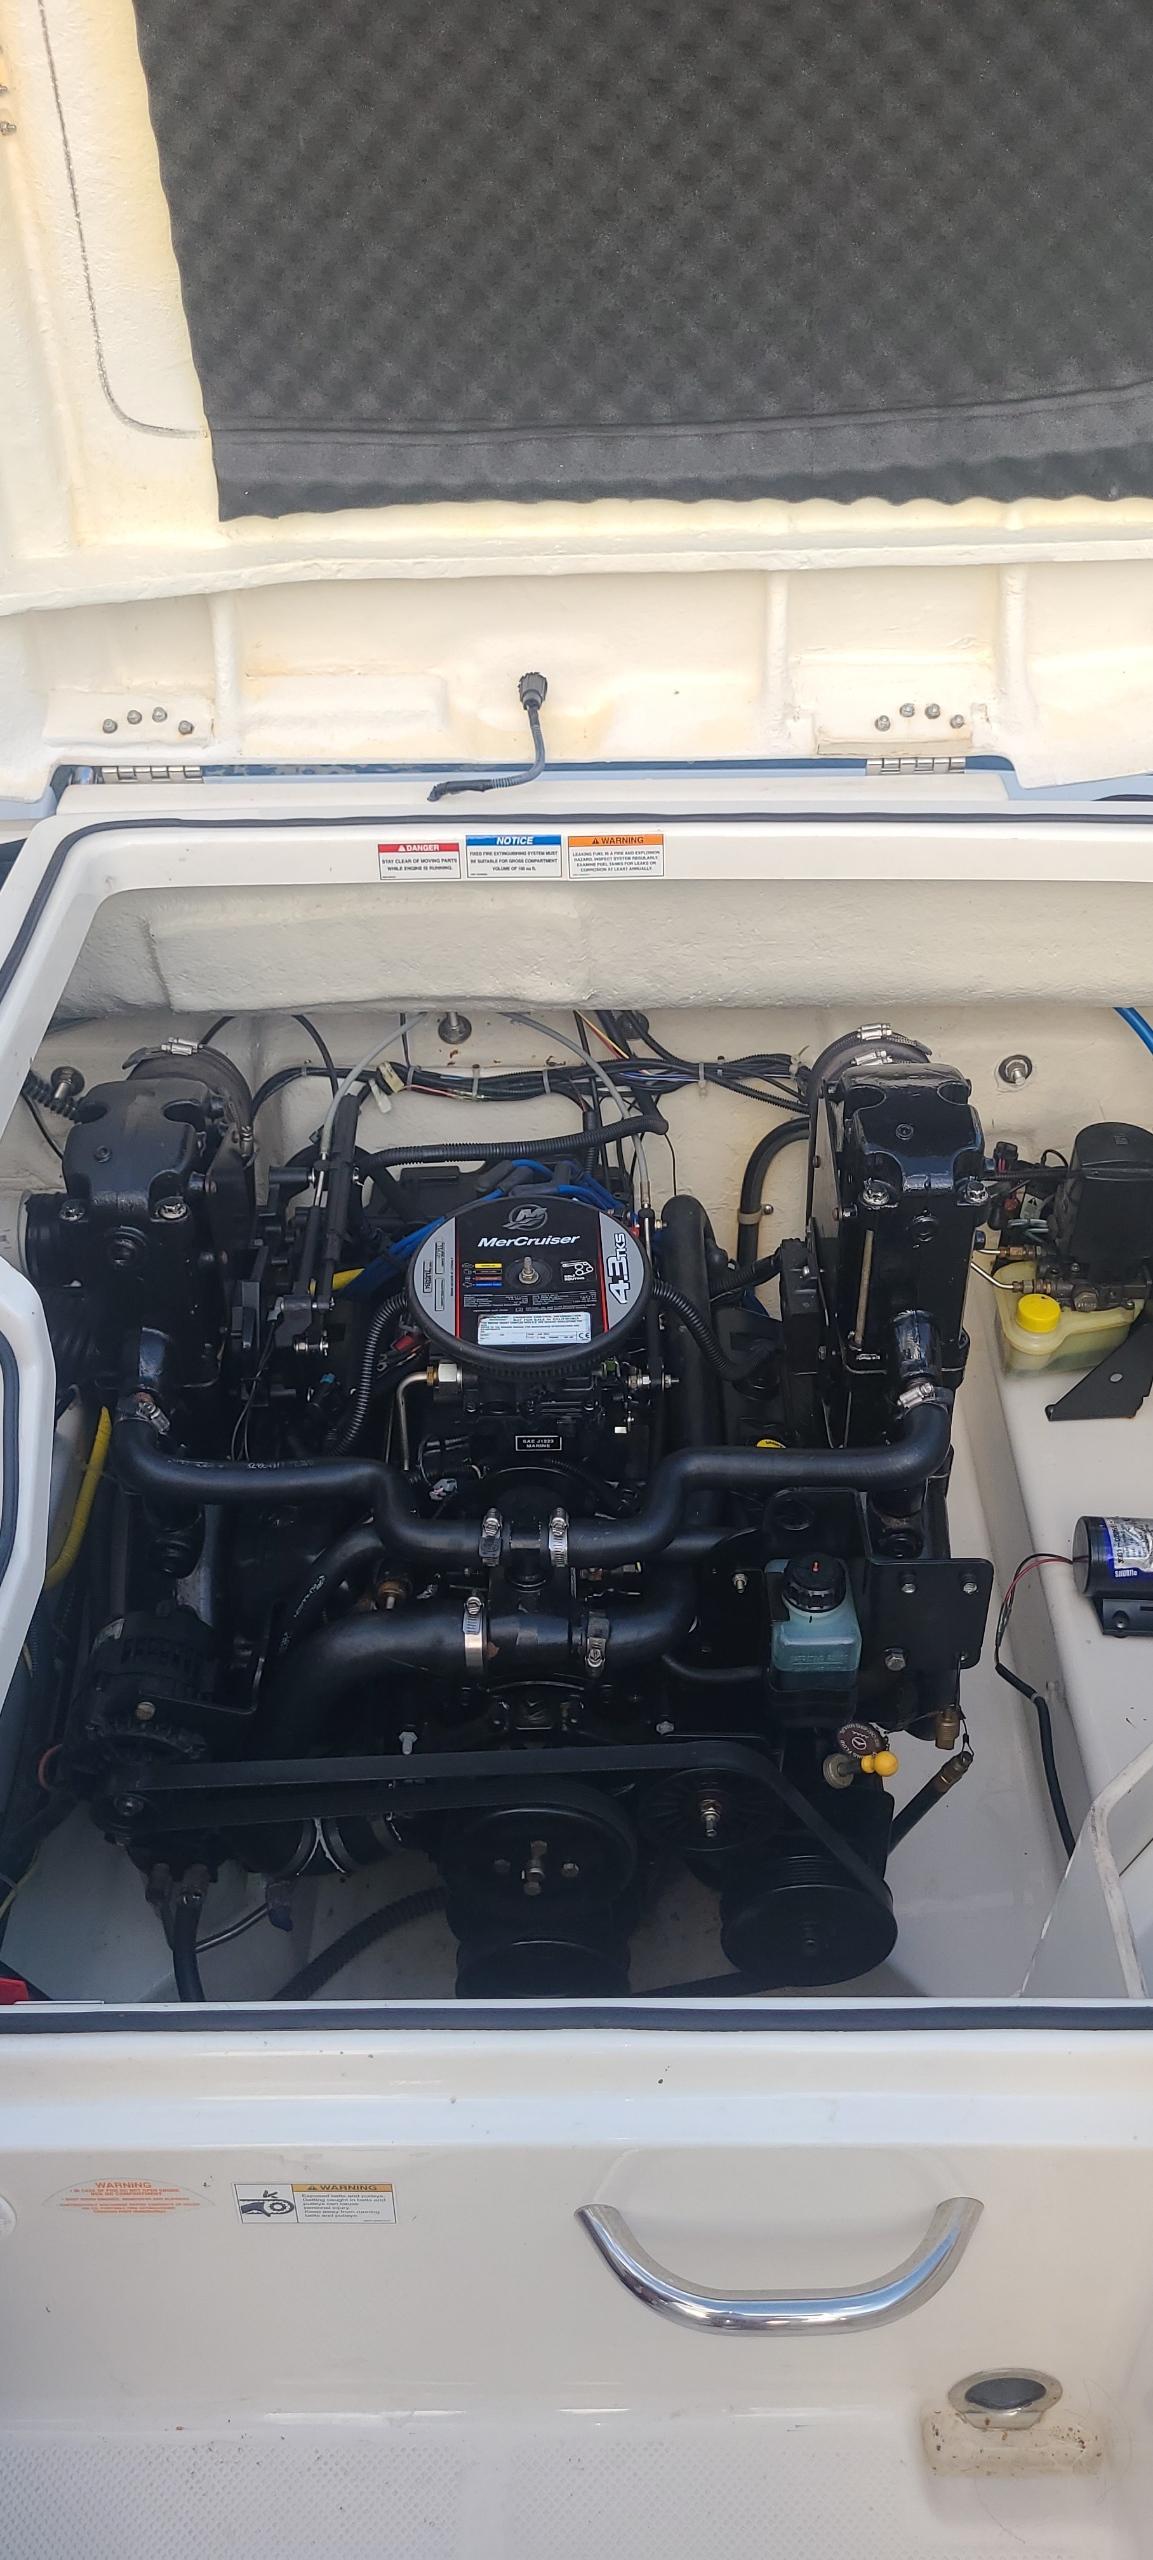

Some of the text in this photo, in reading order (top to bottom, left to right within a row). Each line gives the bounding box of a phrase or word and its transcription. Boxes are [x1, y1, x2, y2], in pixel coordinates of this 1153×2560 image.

[496, 837, 534, 845] NOTICE
[407, 844, 440, 852] DANGER
[477, 1235, 581, 1248] MerCruiser
